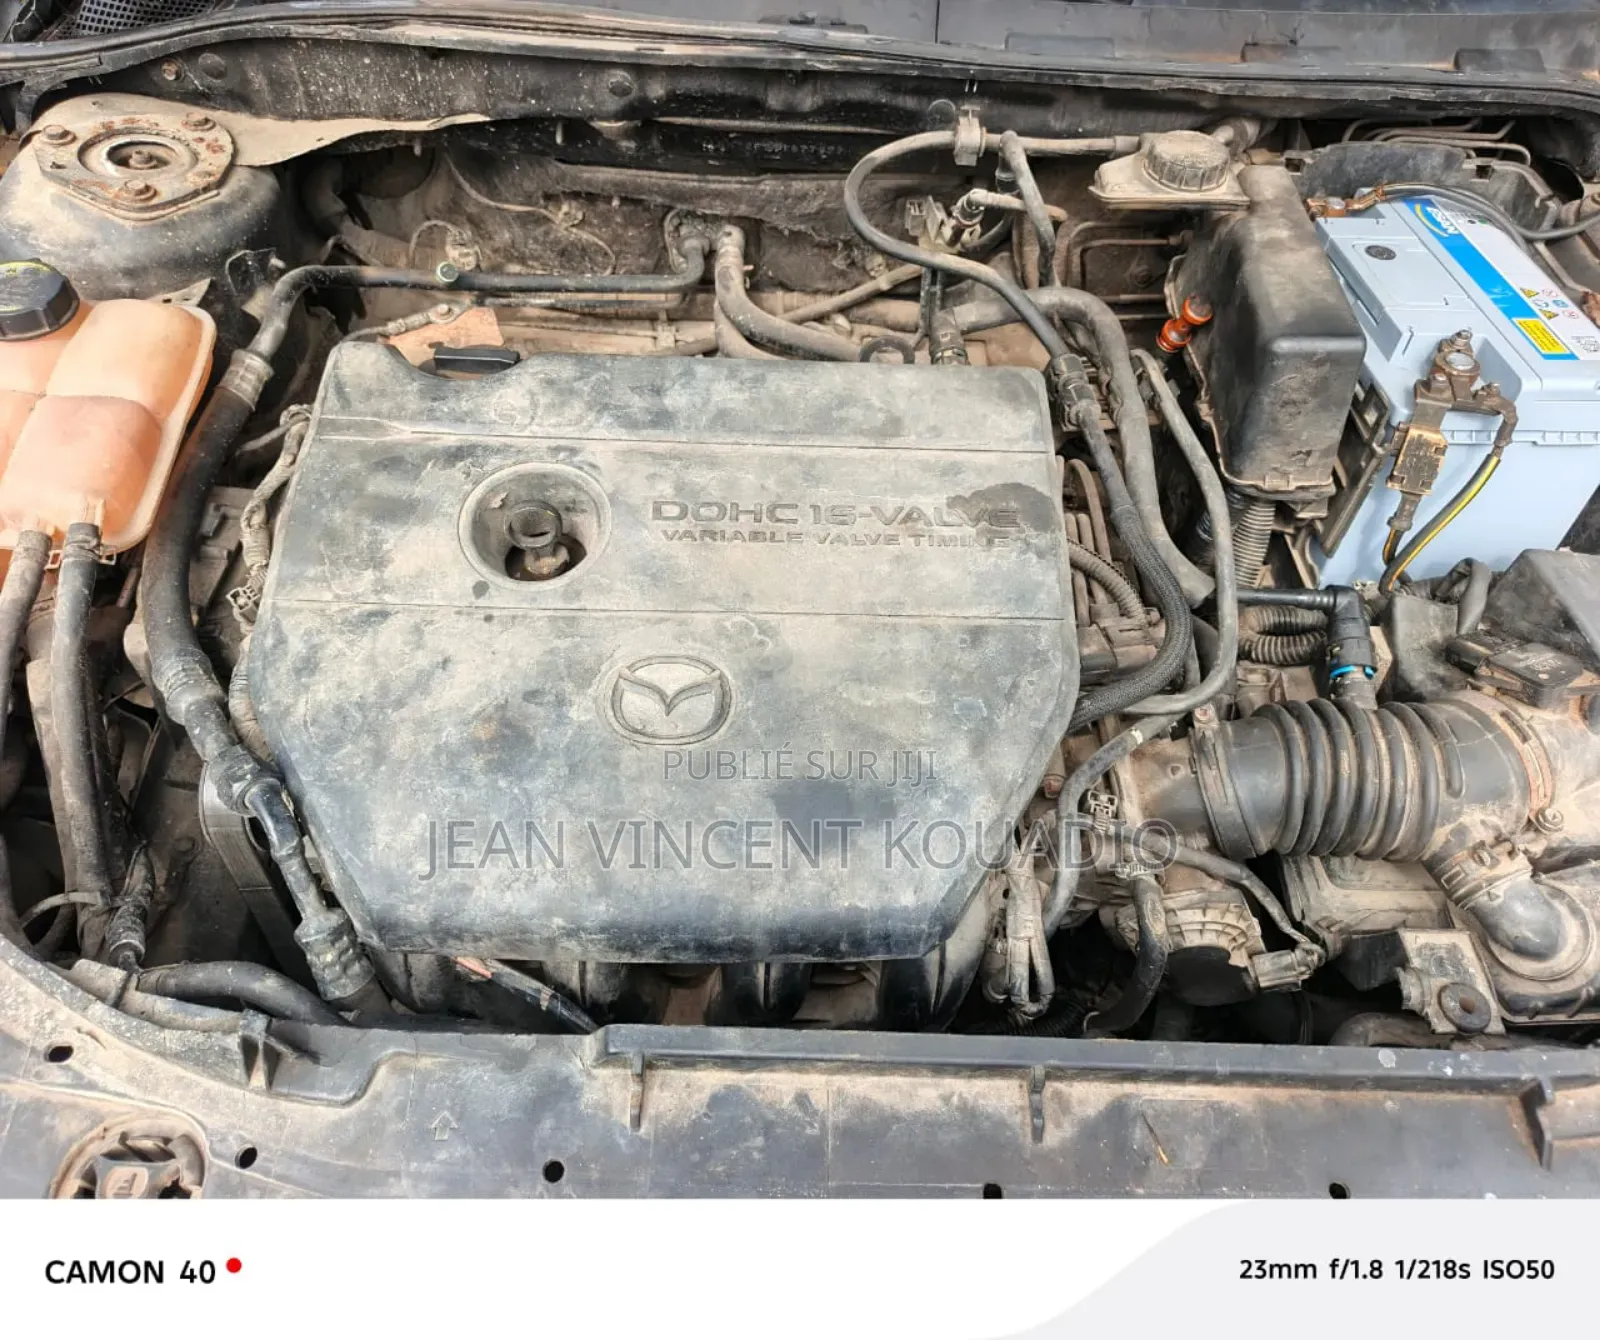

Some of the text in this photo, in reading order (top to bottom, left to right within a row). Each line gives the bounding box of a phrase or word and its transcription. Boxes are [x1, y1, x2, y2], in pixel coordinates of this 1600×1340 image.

[652, 500, 1021, 529] DOHC 16-VALVE
[661, 529, 804, 544] VARIABLE
[815, 532, 901, 547] VALVE
